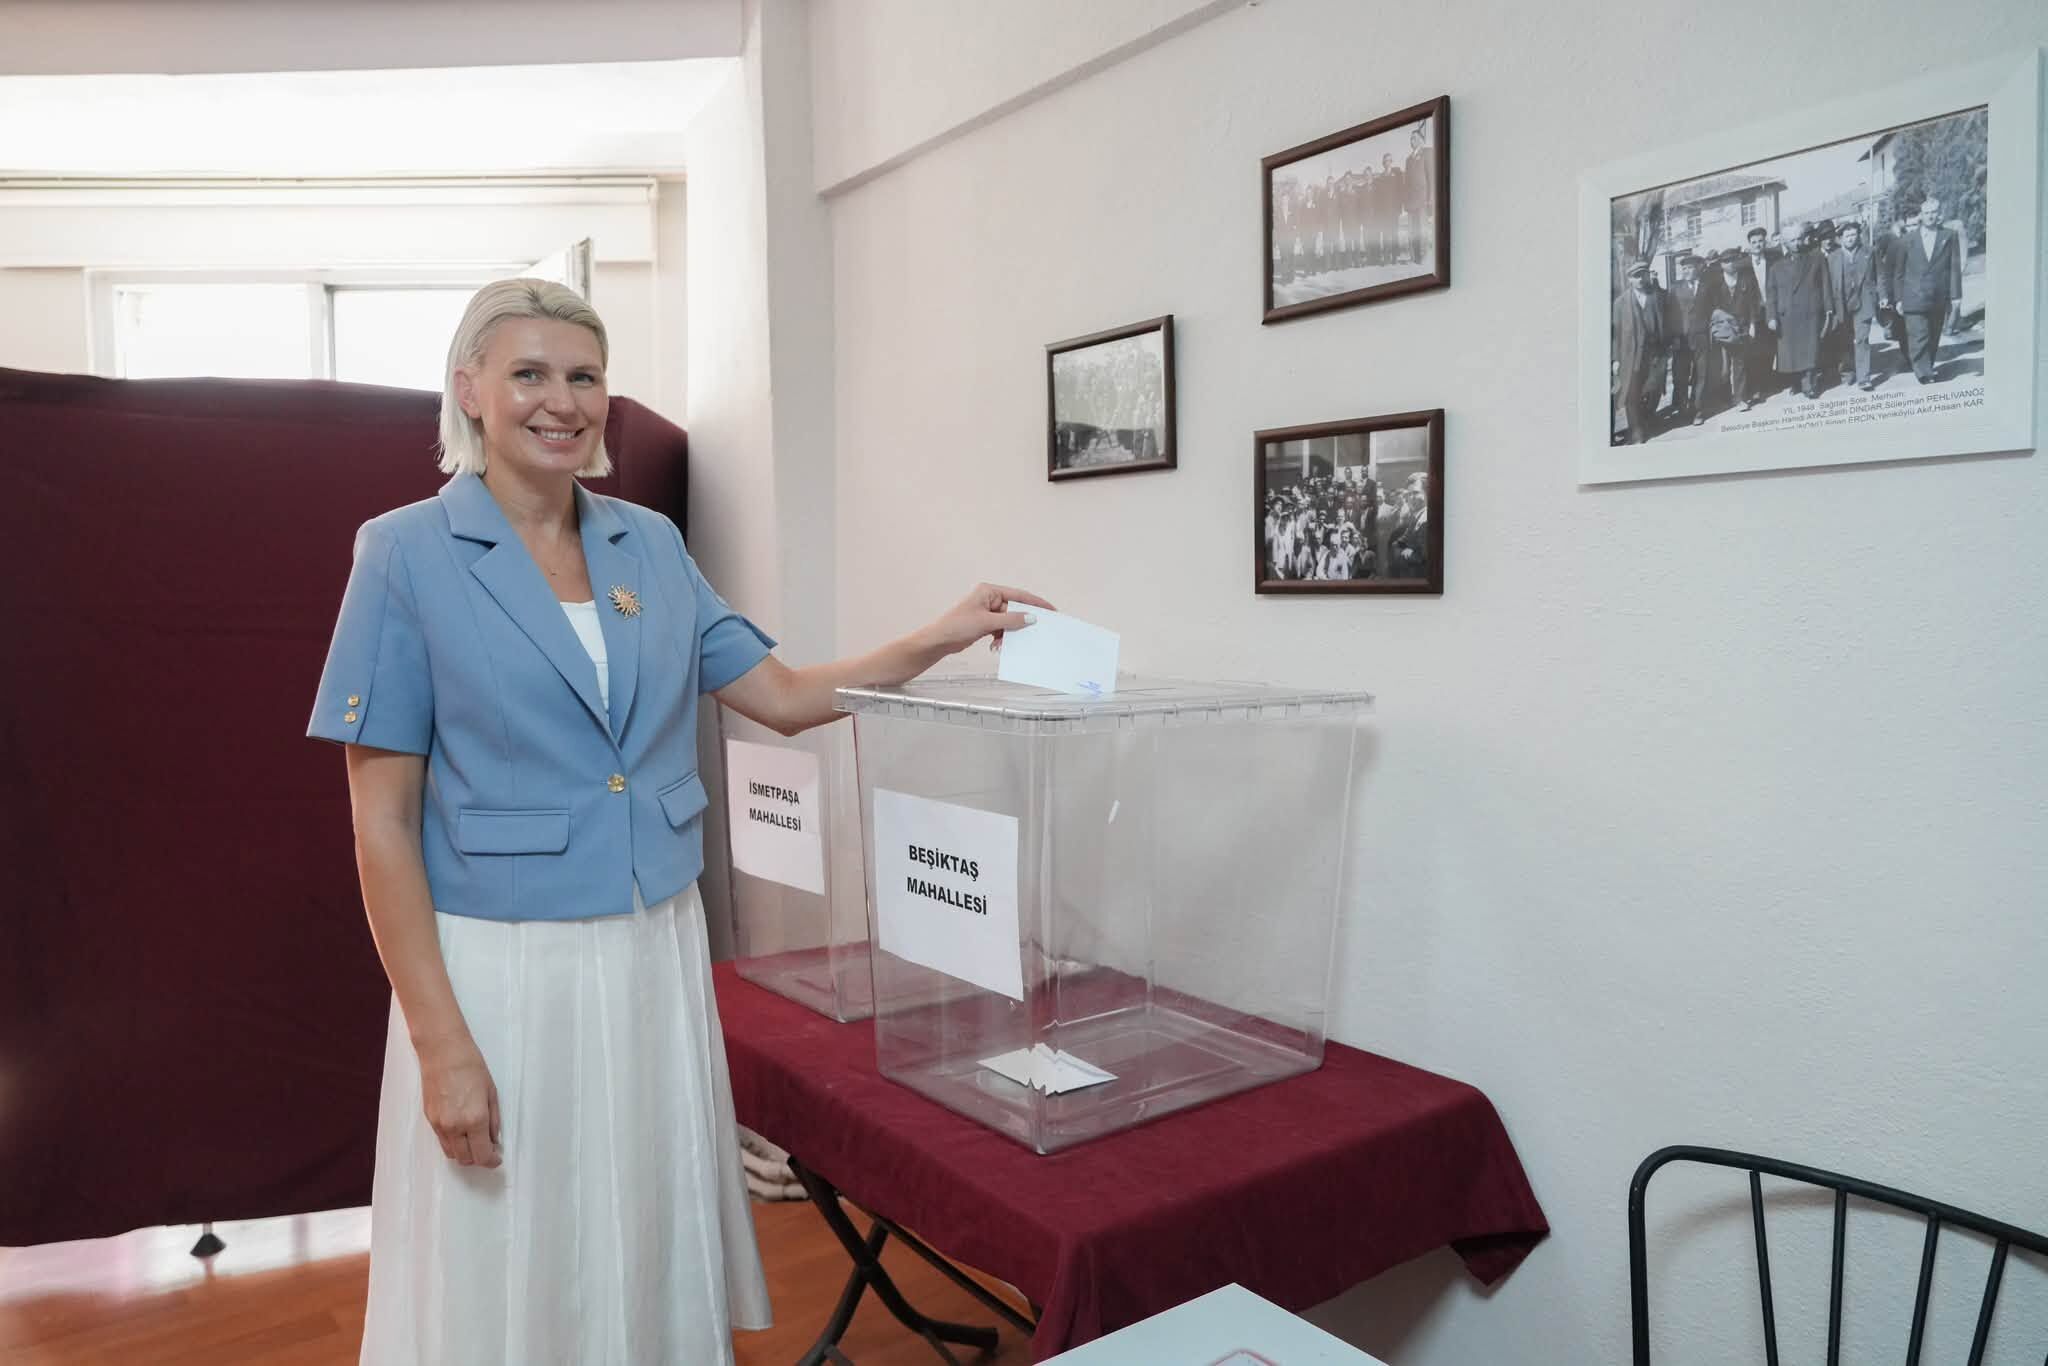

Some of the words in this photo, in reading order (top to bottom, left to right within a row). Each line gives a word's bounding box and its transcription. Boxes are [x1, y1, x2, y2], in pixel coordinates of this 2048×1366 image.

[749, 778, 800, 806] İSMETPAŞA
[749, 807, 801, 832] MAHALLESİ
[909, 844, 979, 882] BEŞİKTAŞ
[907, 876, 987, 915] MAHALLESİ
